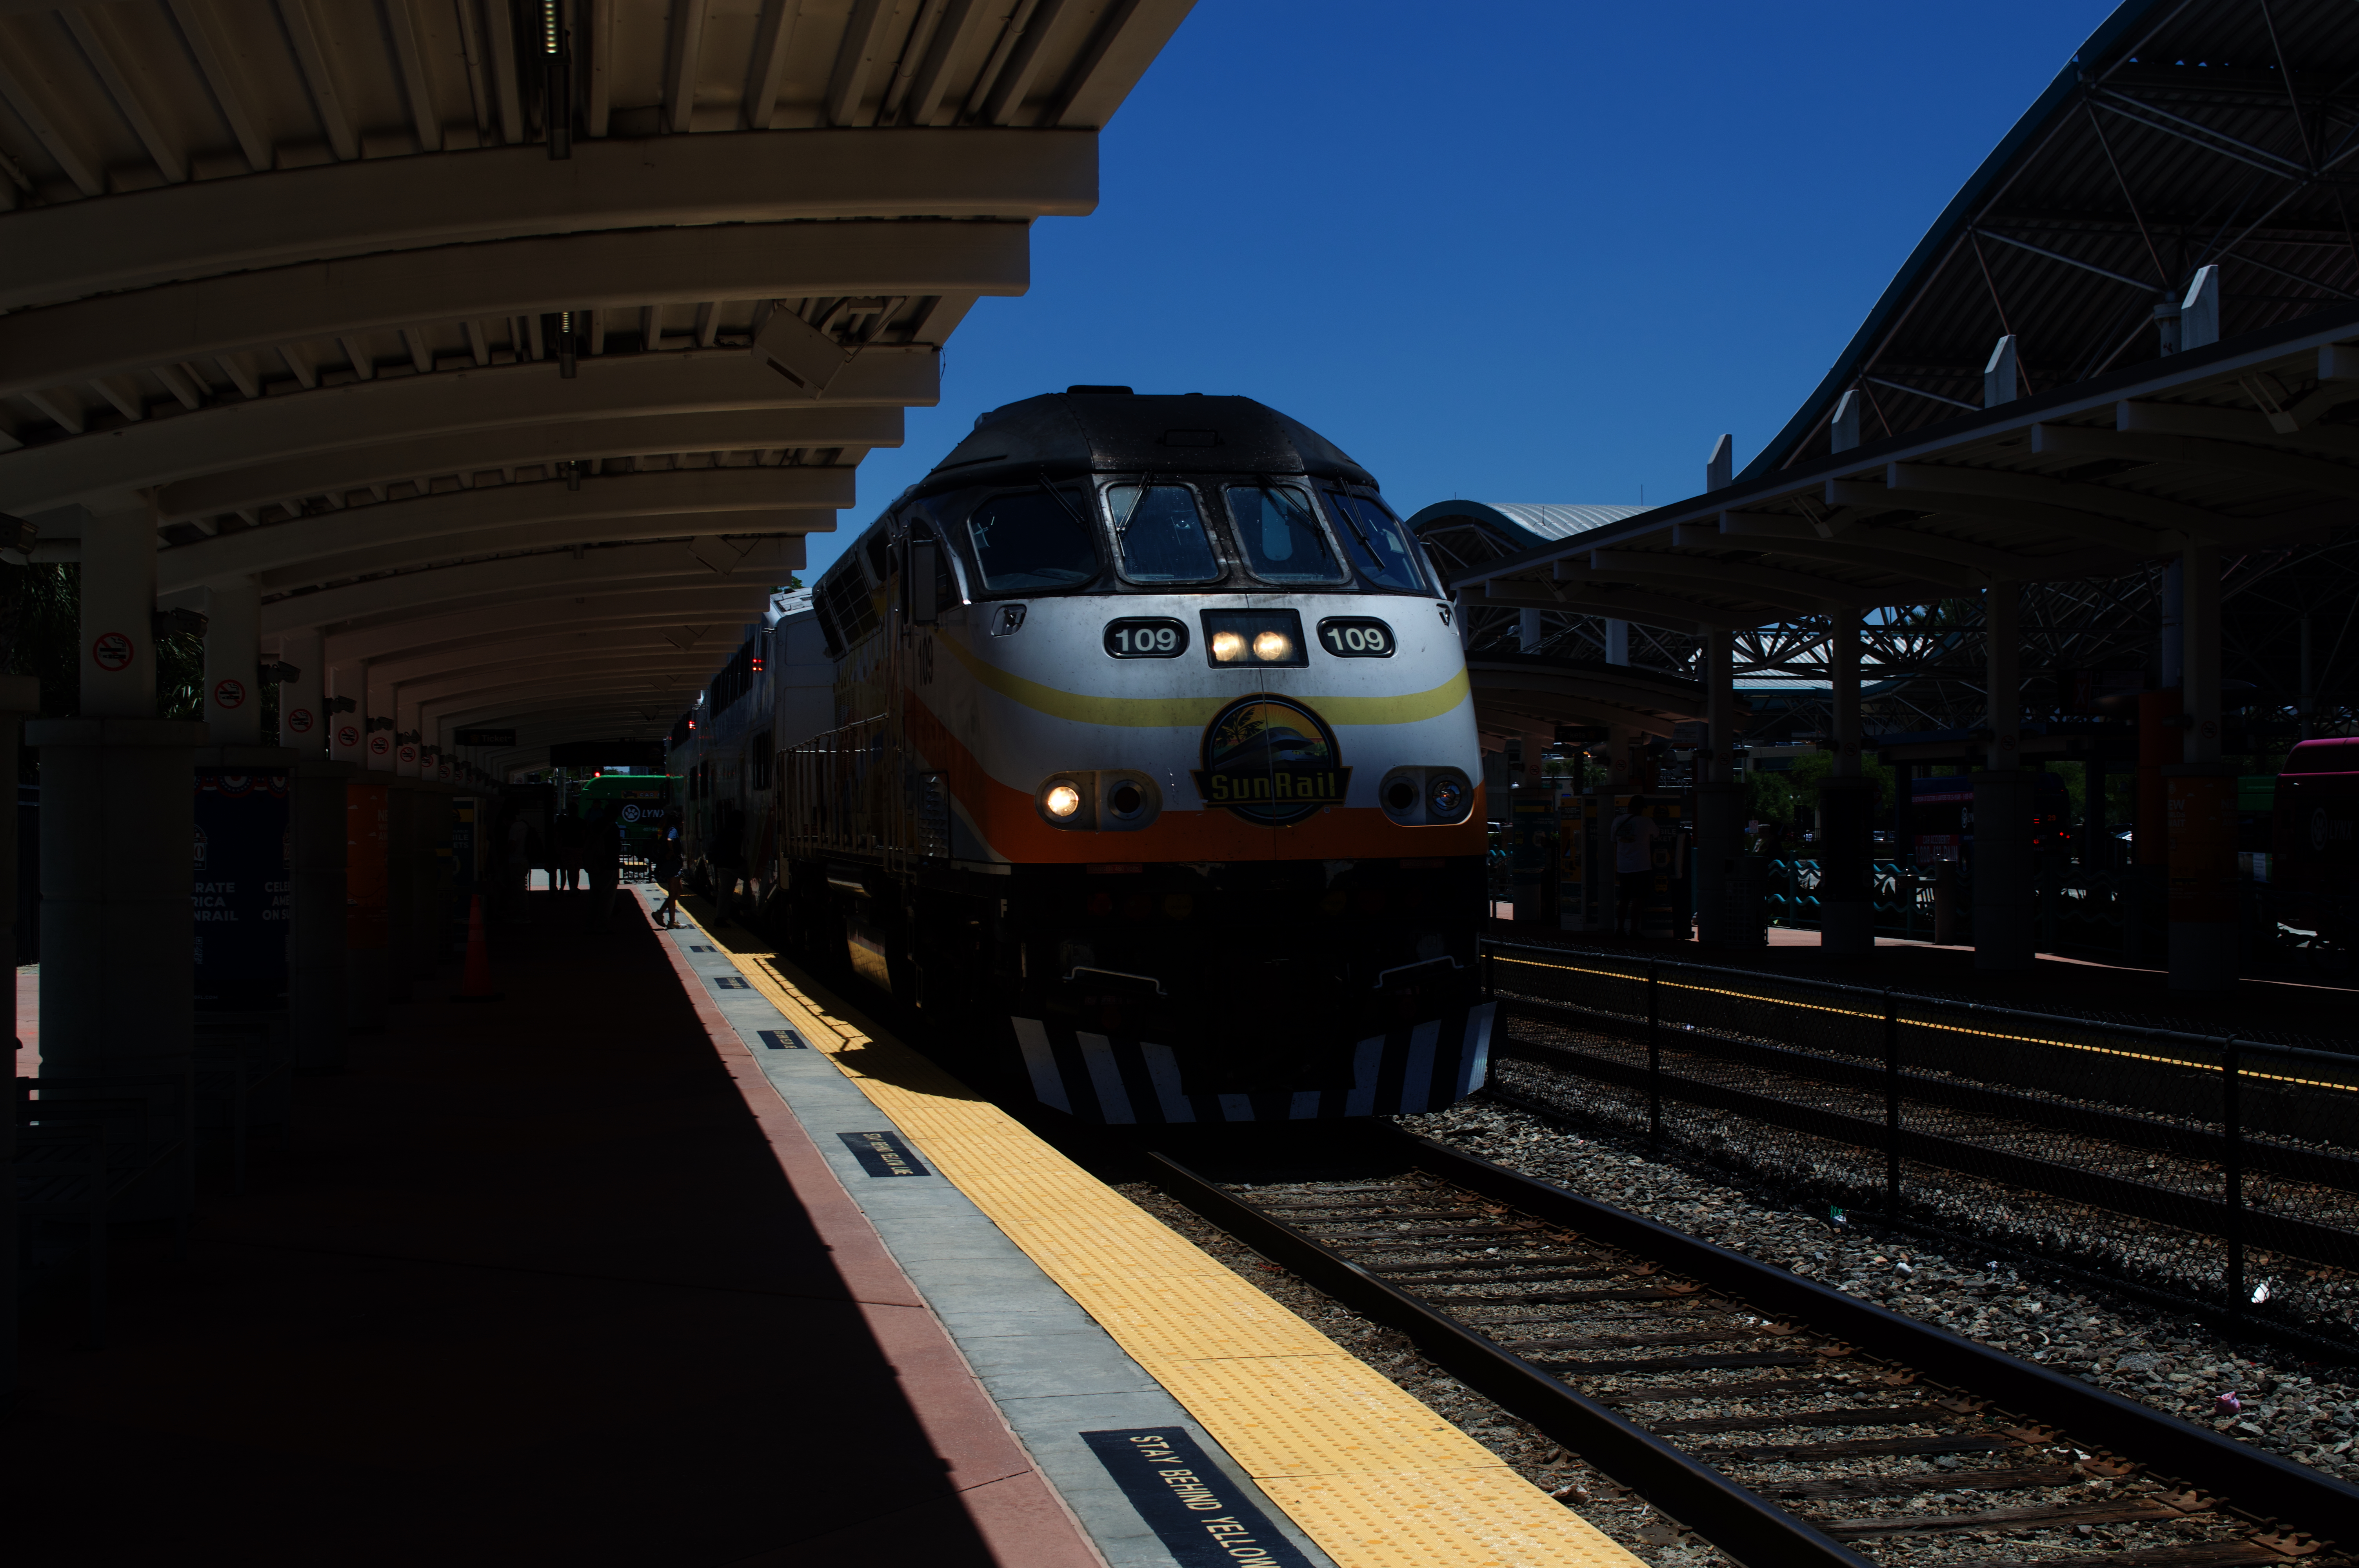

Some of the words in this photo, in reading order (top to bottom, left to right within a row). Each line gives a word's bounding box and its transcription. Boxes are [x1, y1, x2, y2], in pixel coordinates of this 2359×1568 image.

[1116, 628, 1176, 652] 109
[1327, 628, 1385, 651] 109
[918, 635, 933, 686] 109
[2076, 671, 2088, 679] BAY
[2095, 673, 2100, 682] 7
[2074, 683, 2087, 704] X
[1211, 772, 1336, 800] SunRail
[2167, 799, 2185, 810] EW
[2221, 799, 2237, 809] NE
[378, 809, 388, 822] NE
[2328, 819, 2354, 840] LYNX
[196, 882, 235, 893] RATE
[191, 896, 226, 907] RICA
[1000, 899, 1008, 918] F
[194, 910, 239, 921] NRAIL
[863, 1133, 885, 1141] STAY
[870, 1142, 894, 1152] BEHIND
[880, 1152, 907, 1166] YELLOW
[890, 1167, 914, 1175] LINE
[1129, 1435, 1183, 1463] STAY
[1158, 1469, 1223, 1510] BEHIND
[1201, 1516, 1281, 1568] YELLOW
